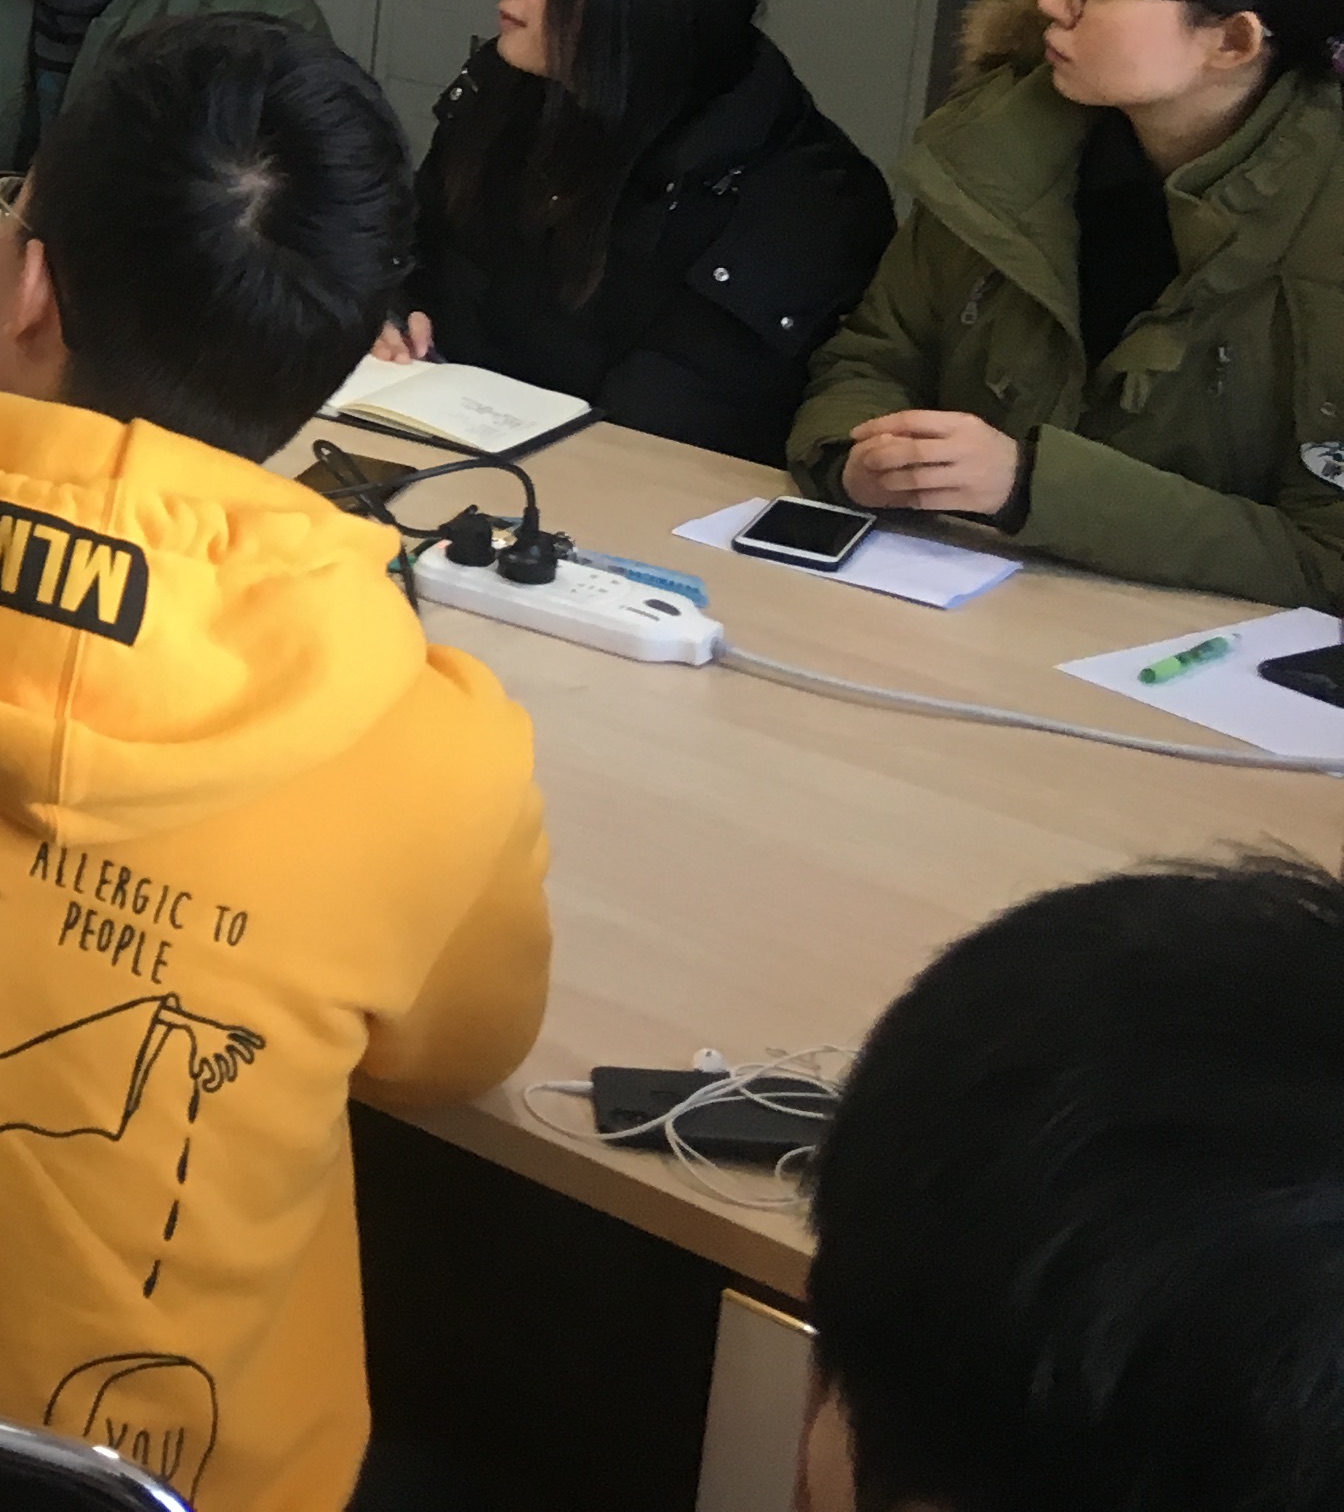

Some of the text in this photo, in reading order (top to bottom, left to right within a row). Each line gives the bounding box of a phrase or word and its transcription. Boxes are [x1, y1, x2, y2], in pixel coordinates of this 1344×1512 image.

[29, 841, 248, 947] ALLERGIC TO
[58, 901, 173, 985] PEOPLE
